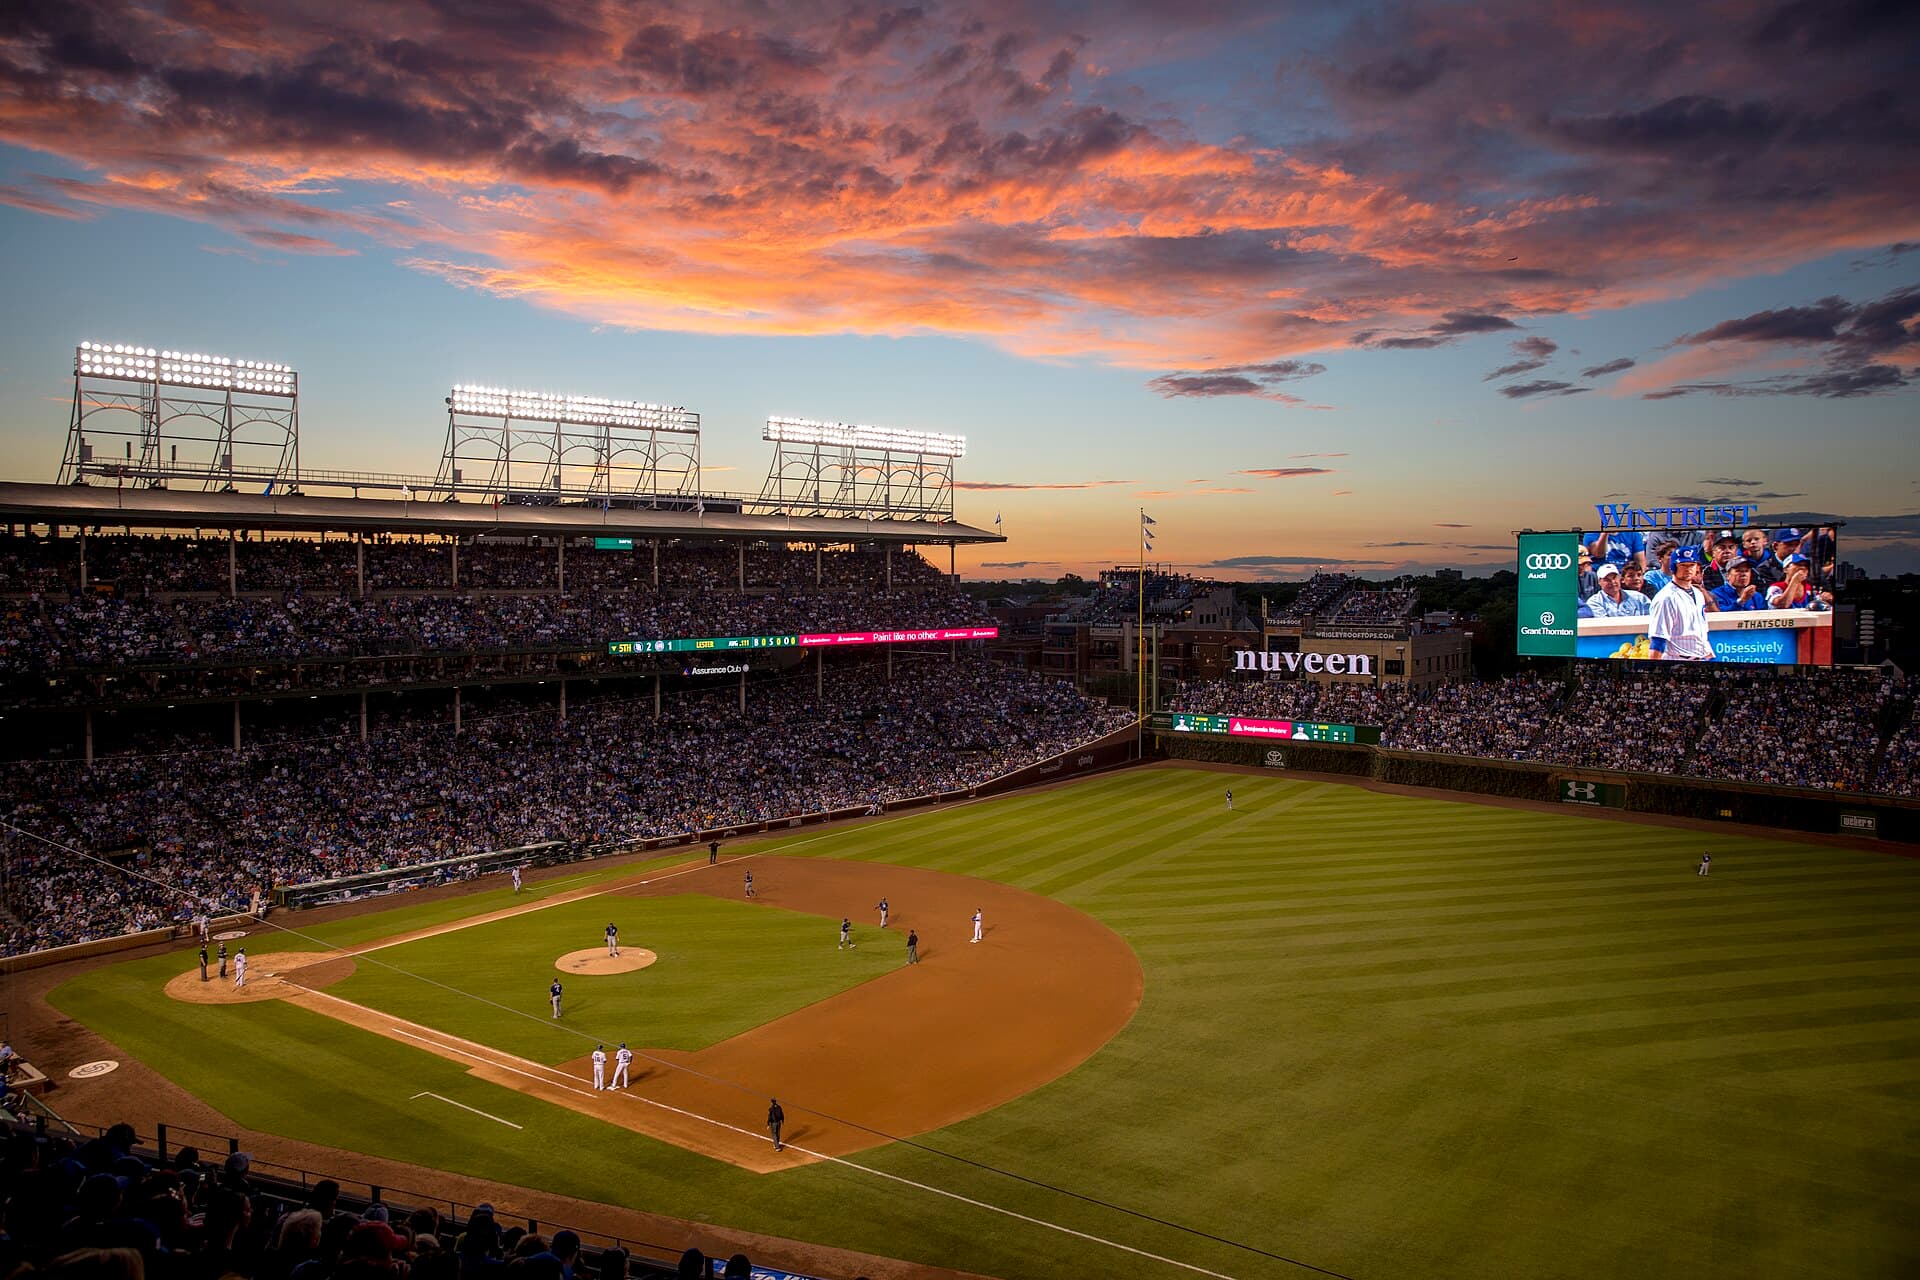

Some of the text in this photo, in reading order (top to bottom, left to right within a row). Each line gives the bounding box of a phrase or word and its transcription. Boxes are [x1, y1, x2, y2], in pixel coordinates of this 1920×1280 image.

[1737, 619, 1794, 628] #THATSCUB
[873, 633, 891, 641] Paint
[893, 632, 906, 641] like
[1316, 631, 1394, 639] WRIGLEYROOFTOPS.COM
[1521, 627, 1574, 636] Grant Thornton
[619, 643, 632, 653] 5TH
[646, 642, 652, 651] 2
[667, 641, 672, 650] 1
[1716, 641, 1784, 655] Obsessively
[1234, 650, 1372, 675] nuveen
[692, 664, 741, 675] Assurance Club
